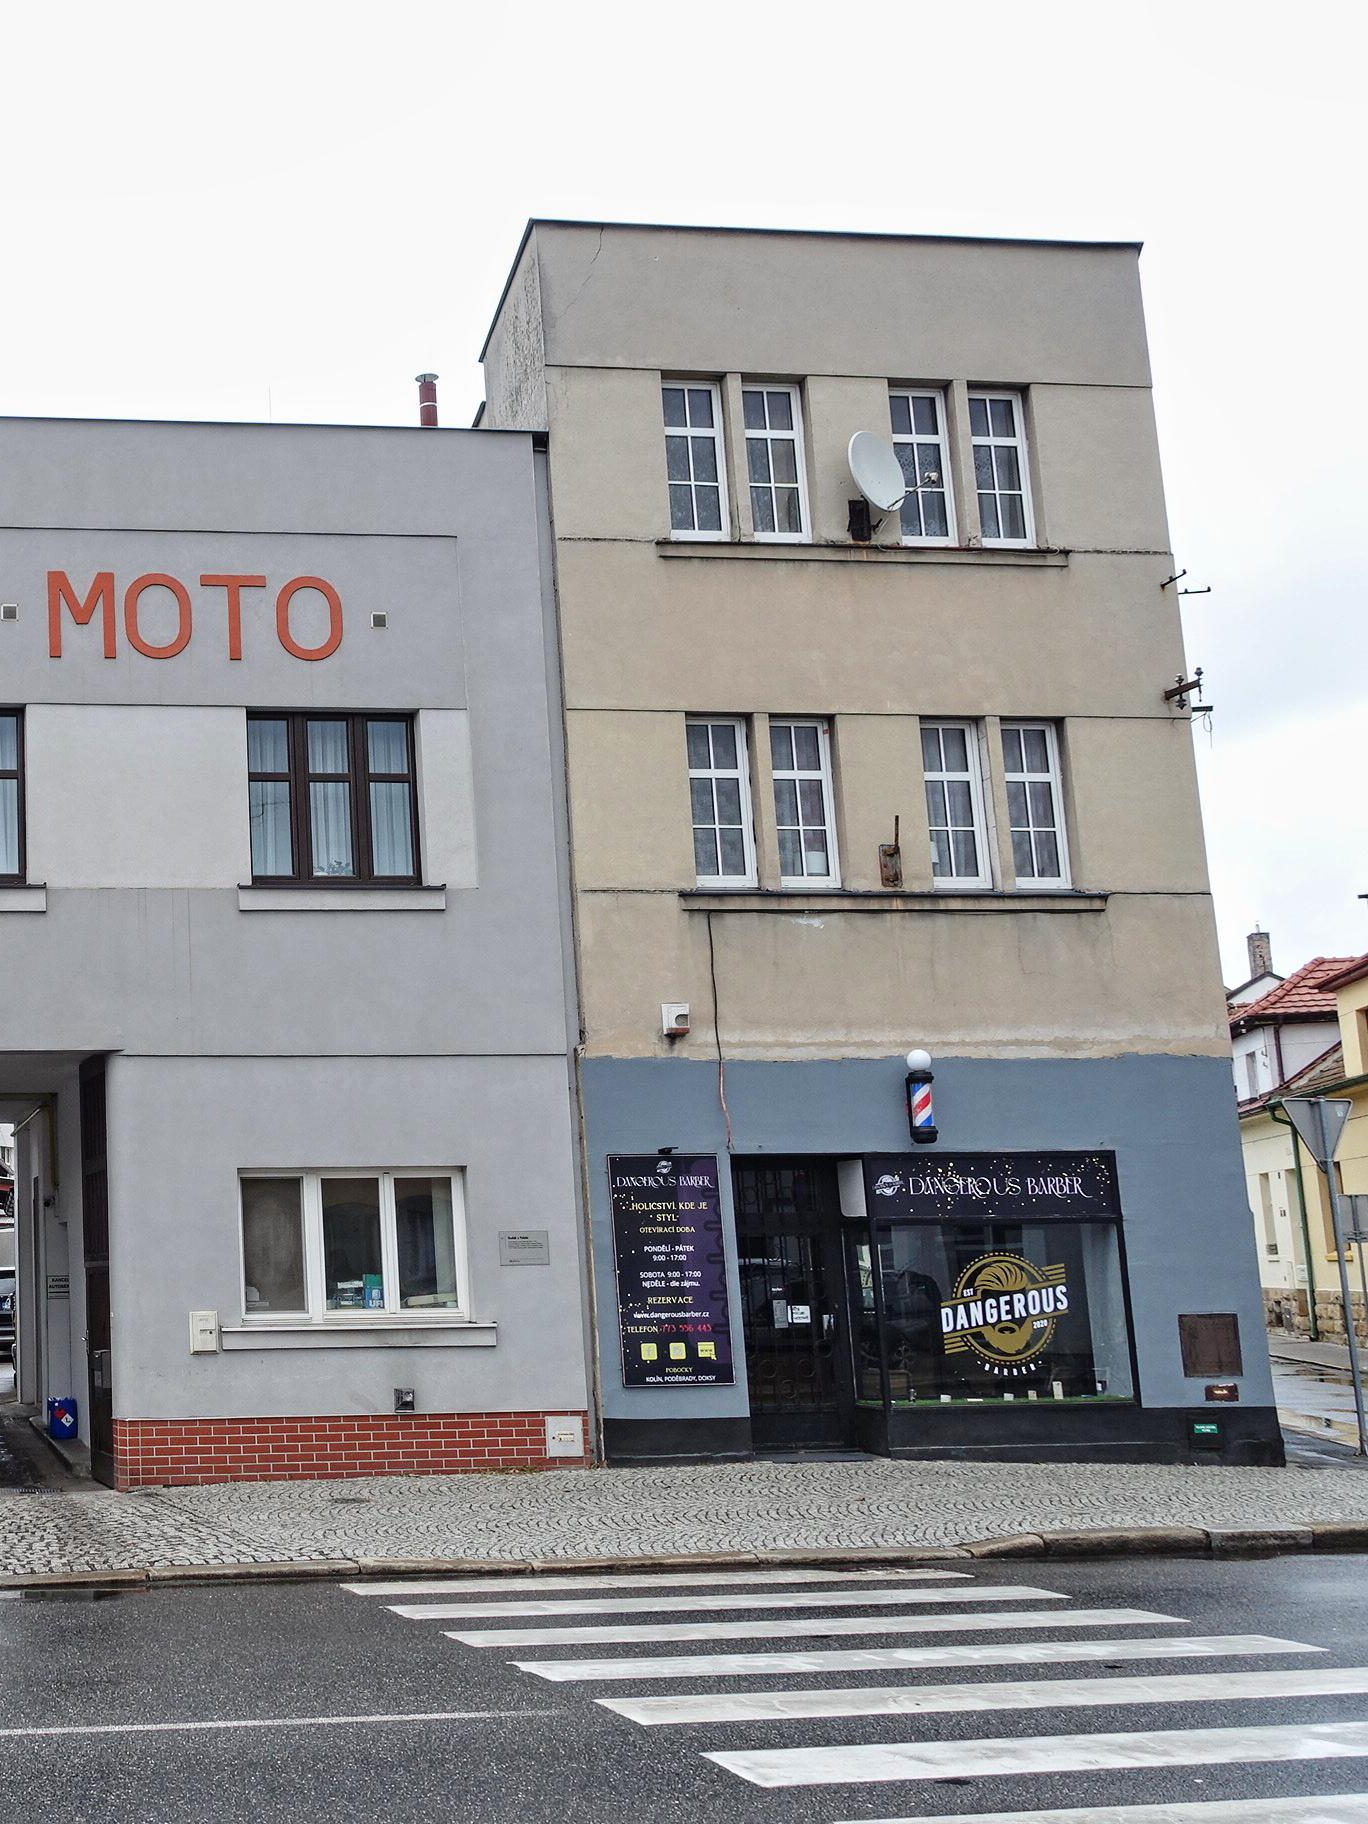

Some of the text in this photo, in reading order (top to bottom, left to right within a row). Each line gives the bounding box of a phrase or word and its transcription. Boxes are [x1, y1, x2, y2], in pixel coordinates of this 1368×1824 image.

[47, 570, 343, 661] MOTO
[679, 1174, 715, 1188] BARBER
[909, 1176, 1021, 1198] DANGEROUS
[1027, 1176, 1093, 1198] BARBER
[678, 1202, 696, 1210] KDE
[697, 1201, 708, 1210] JE
[676, 1226, 696, 1234] DOBA
[675, 1244, 695, 1252] PÁTEK
[639, 1271, 666, 1279] SOBOTA
[641, 1280, 666, 1288] NEDĚLE
[963, 1288, 974, 1297] EST
[647, 1296, 694, 1304] REZERVACE
[940, 1285, 1069, 1333] DANGEROUS
[1032, 1319, 1048, 1329] 2020
[984, 1363, 1037, 1376] BARBER
